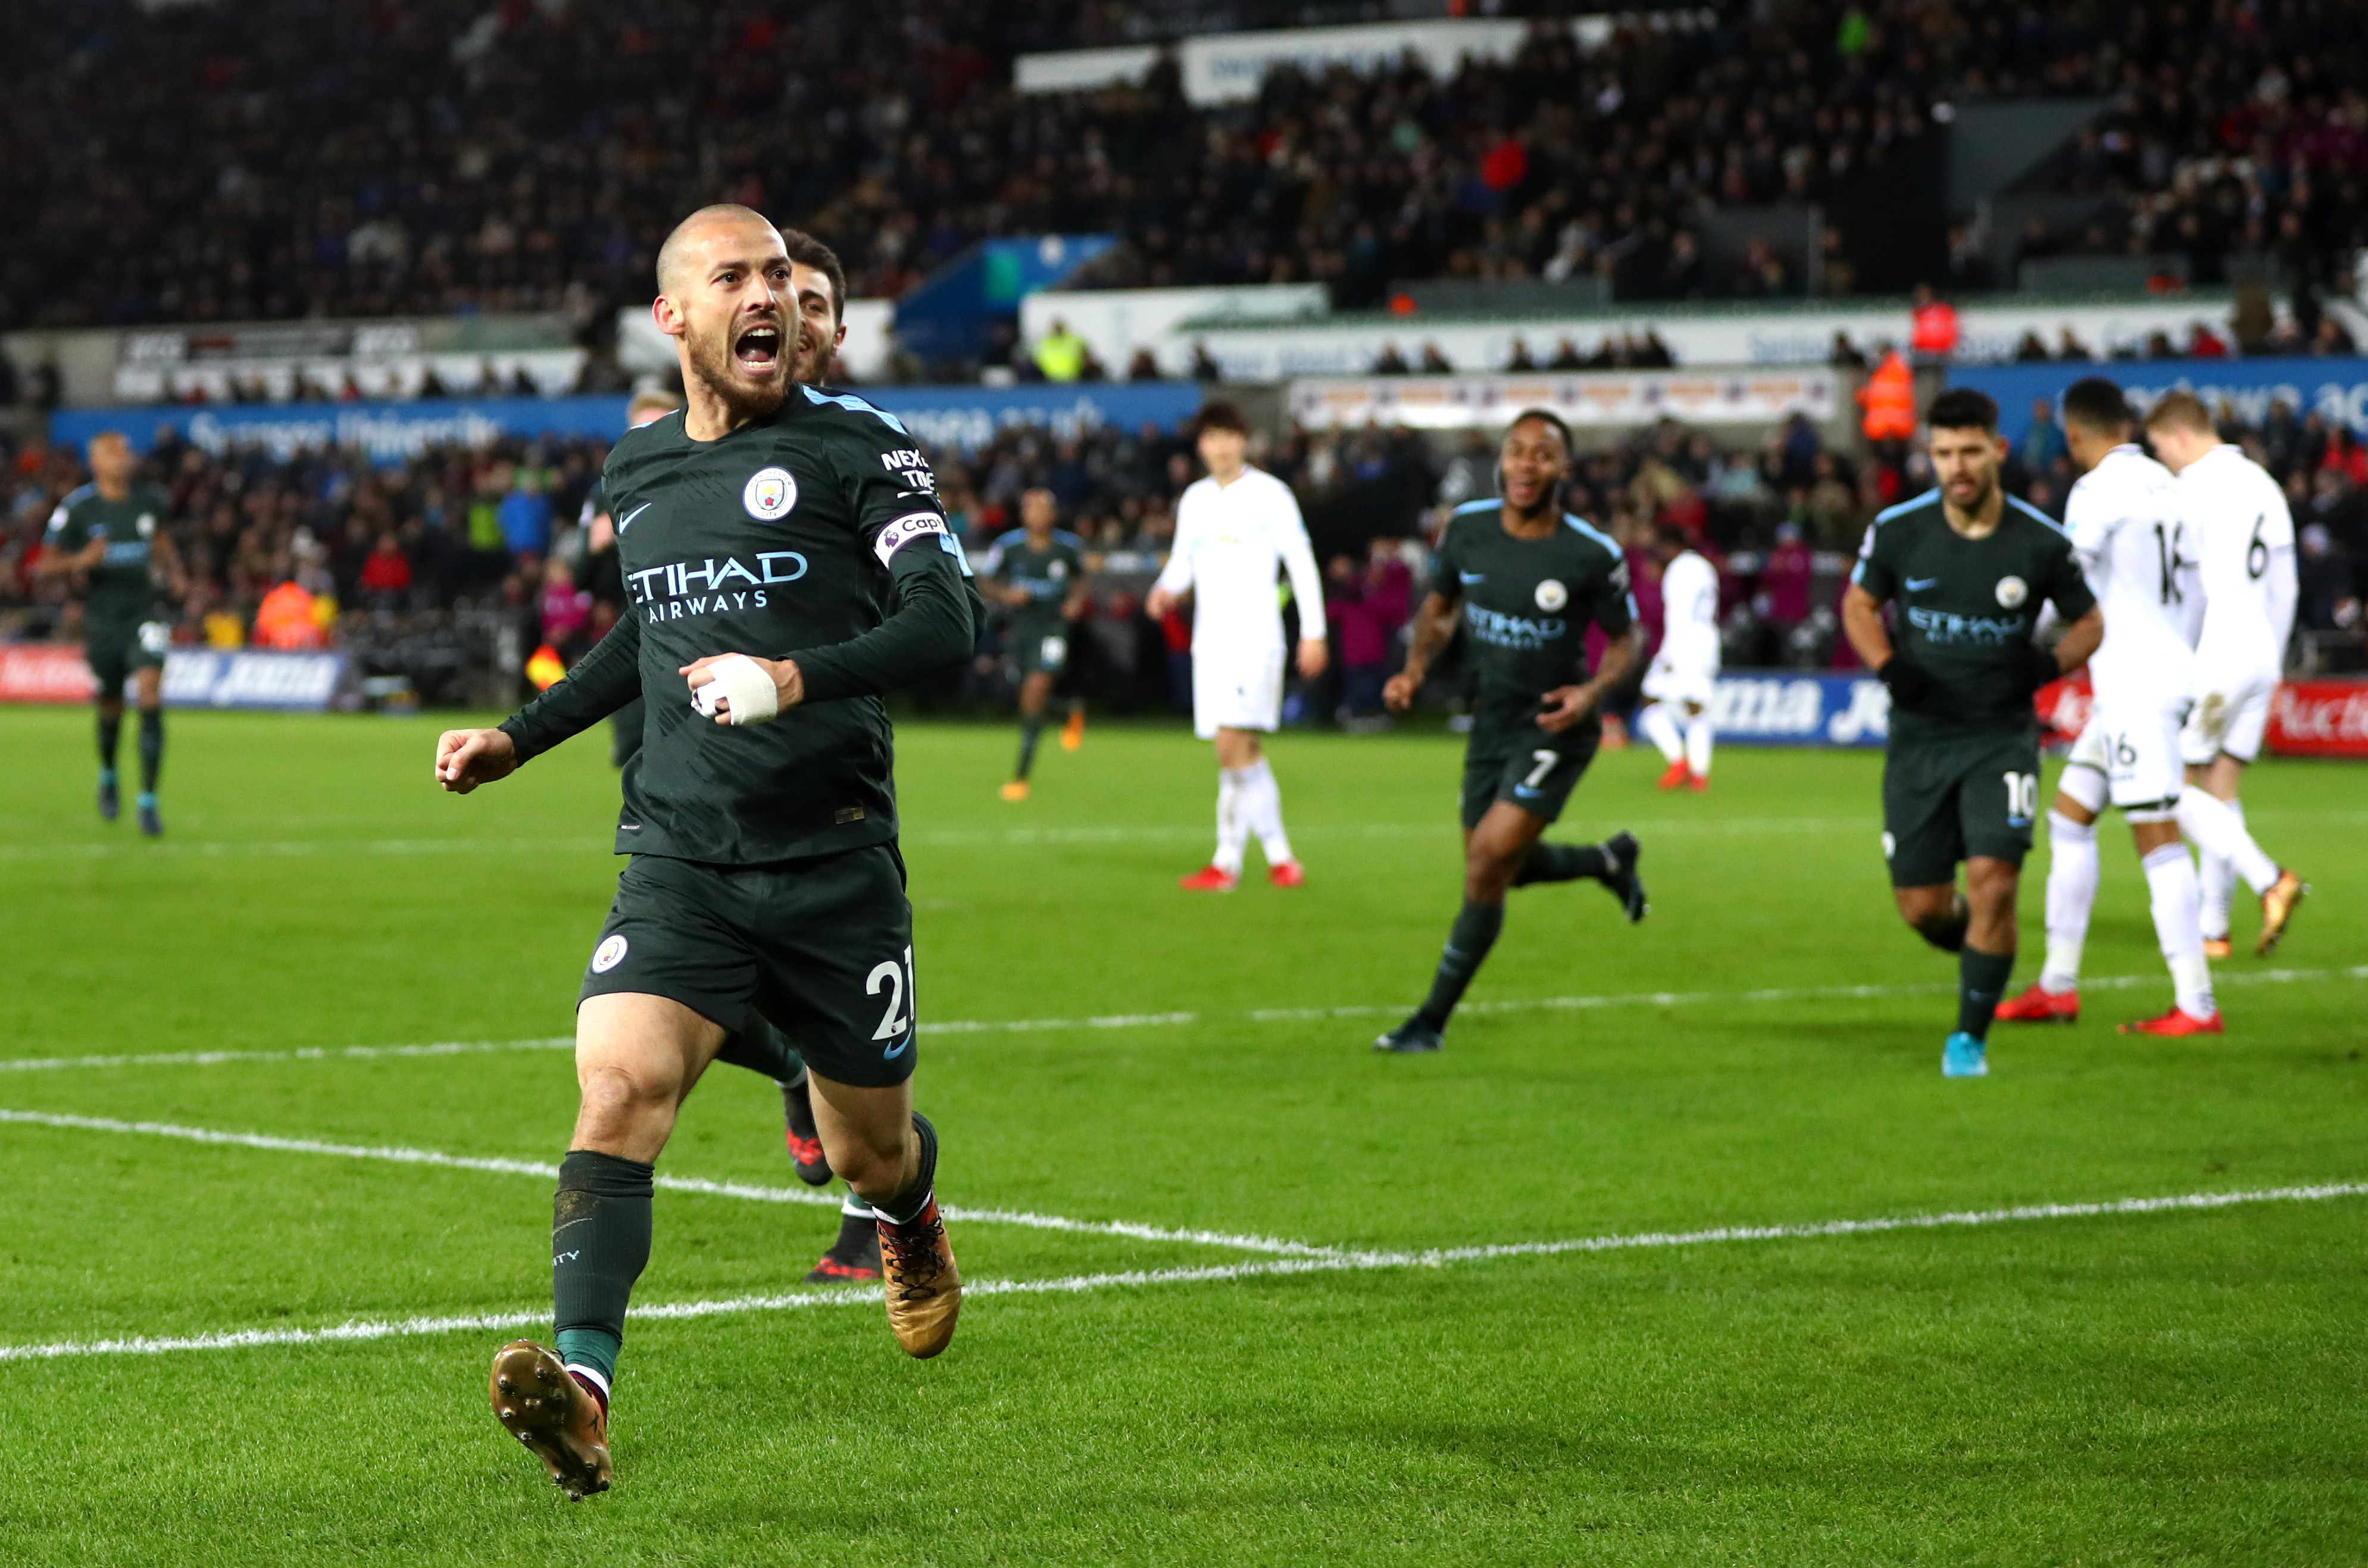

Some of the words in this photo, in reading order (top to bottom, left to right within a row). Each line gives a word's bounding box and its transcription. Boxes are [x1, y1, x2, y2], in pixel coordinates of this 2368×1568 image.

[2246, 512, 2269, 580] 6
[627, 551, 808, 604] ETIHAD
[648, 590, 767, 624] AIRWAYS
[1524, 749, 1560, 788] 7
[2104, 730, 2138, 767] 16
[2003, 771, 2038, 818] 10
[865, 944, 915, 1041] 21
[553, 1250, 580, 1266] ITY
